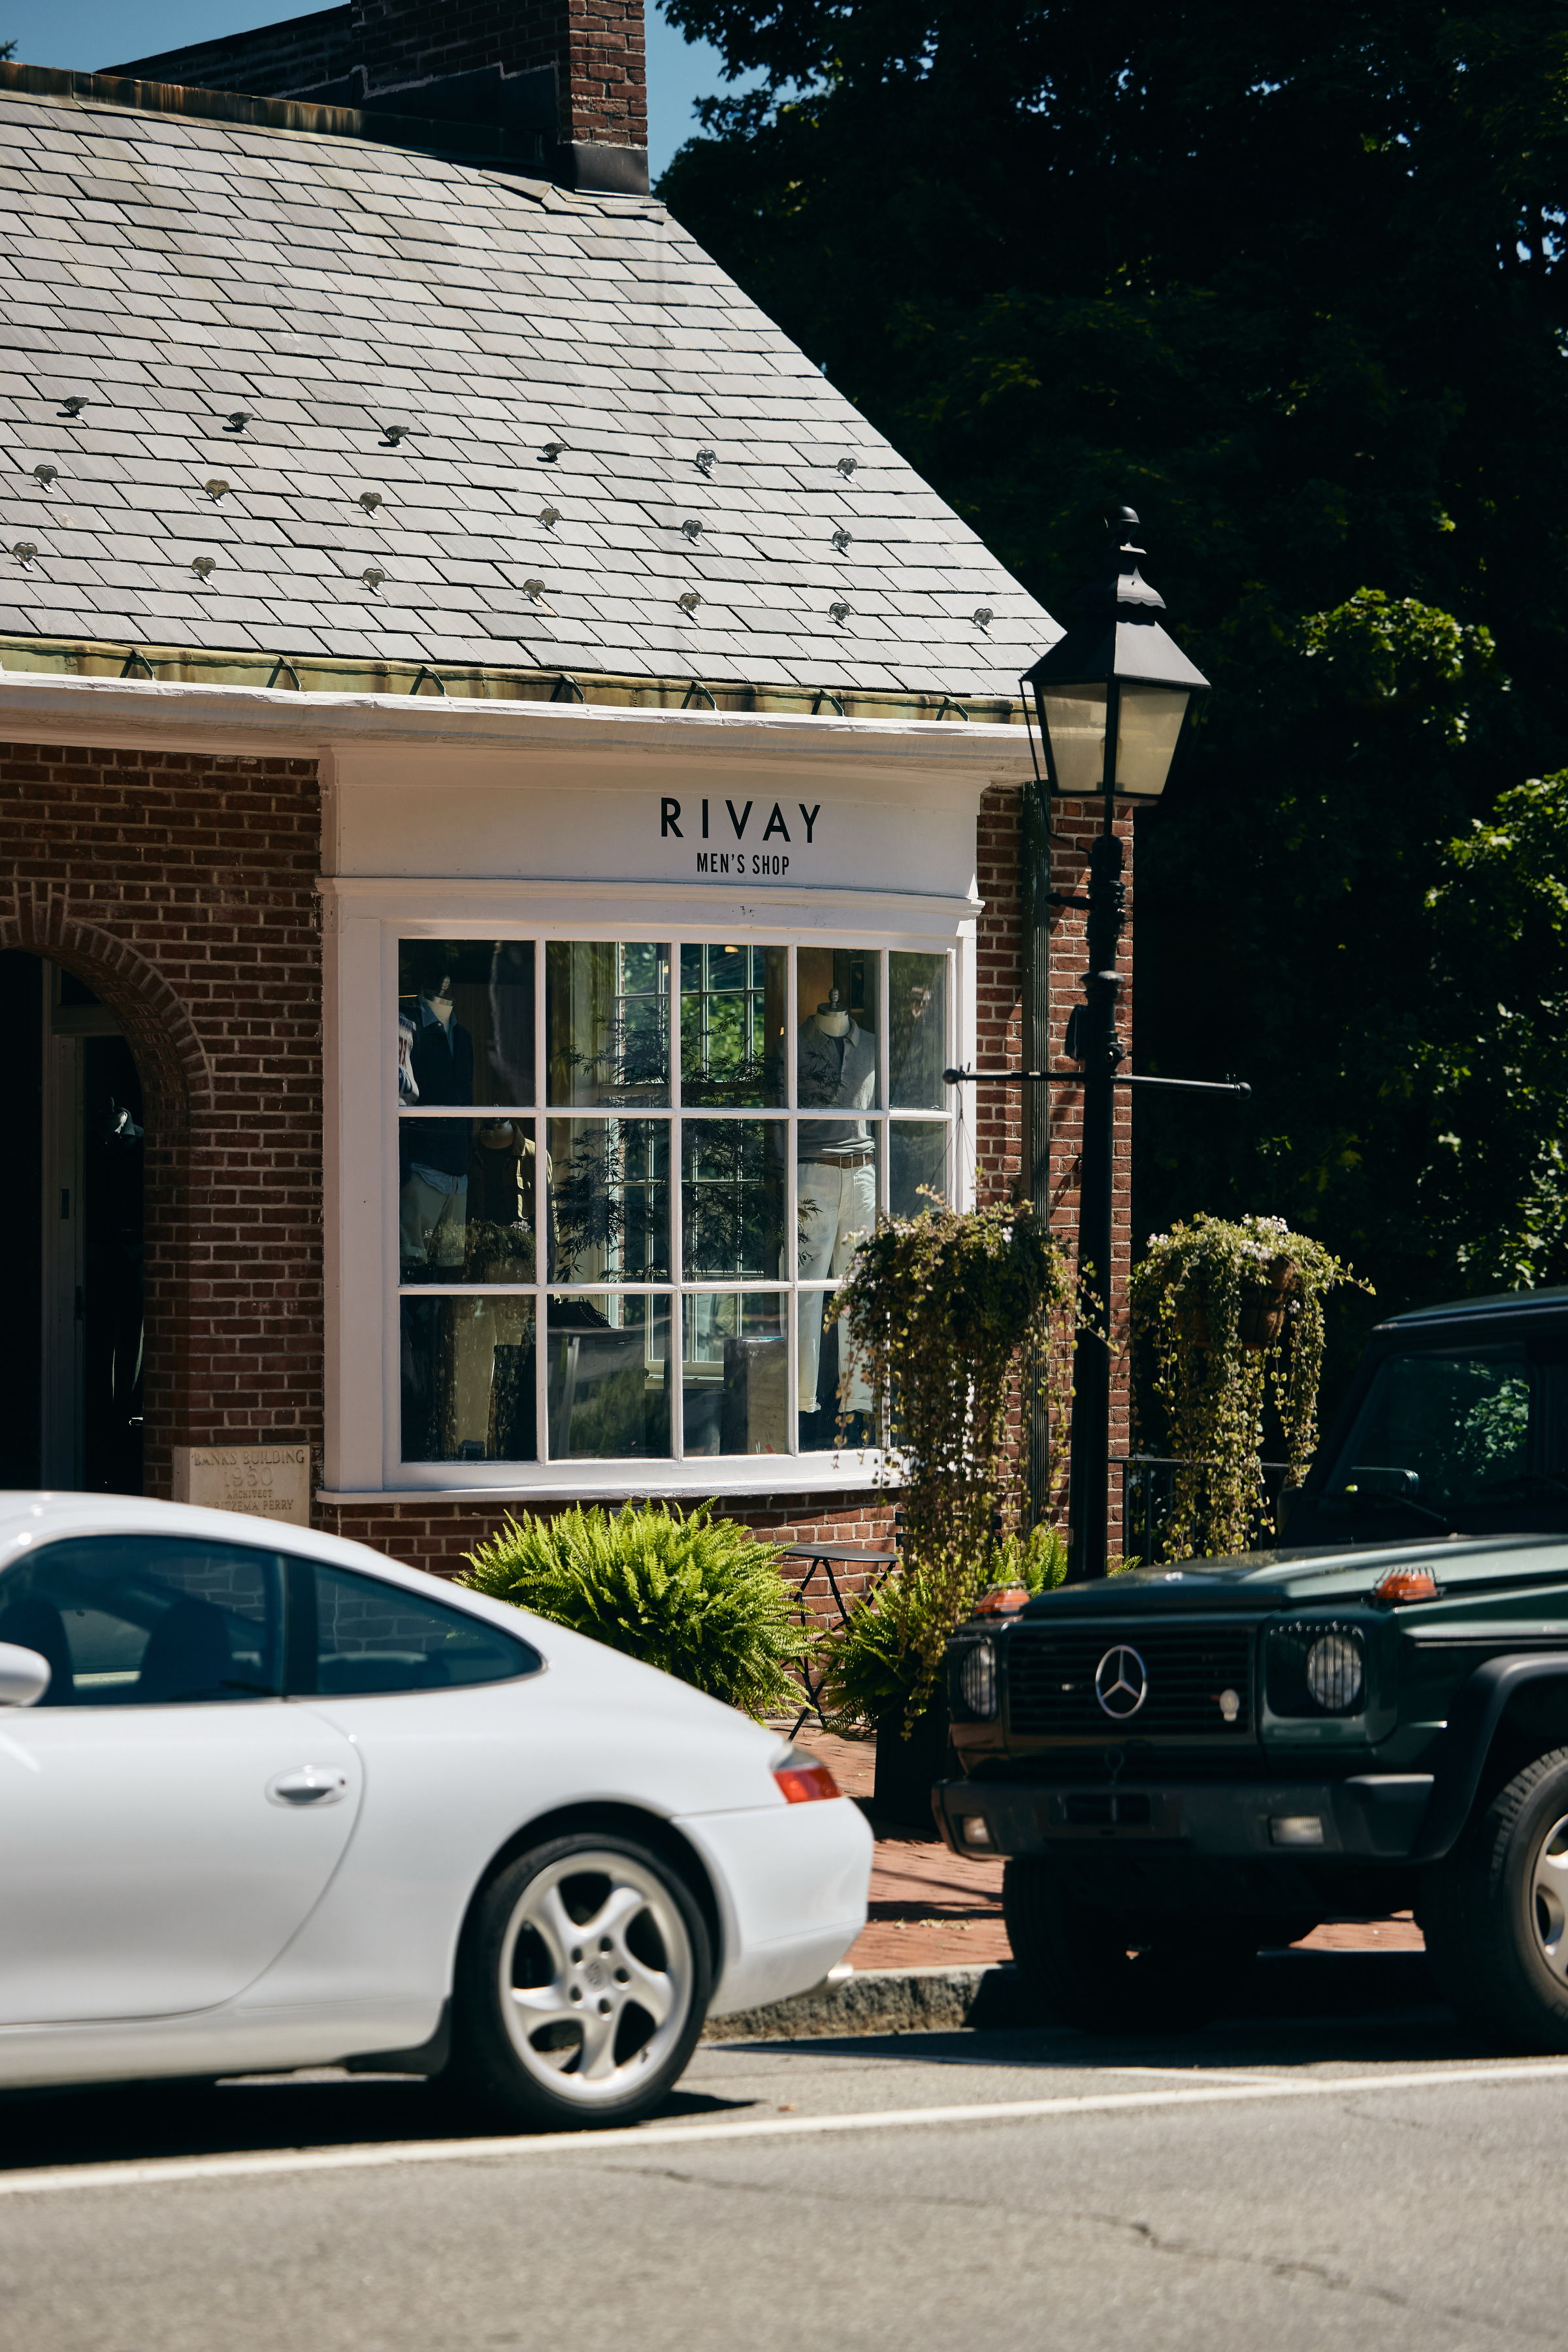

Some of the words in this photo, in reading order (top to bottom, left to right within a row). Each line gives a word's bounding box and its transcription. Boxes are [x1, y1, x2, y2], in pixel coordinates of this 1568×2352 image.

[661, 797, 821, 843] RIVAY
[696, 853, 745, 874] MEN'S
[752, 855, 790, 875] SHOP
[194, 1451, 237, 1465] BANKS
[244, 1449, 304, 1465] BUILDING
[224, 1467, 274, 1487] 1950
[227, 1489, 273, 1499] ARCHITECT
[263, 1499, 293, 1511] PERRY
